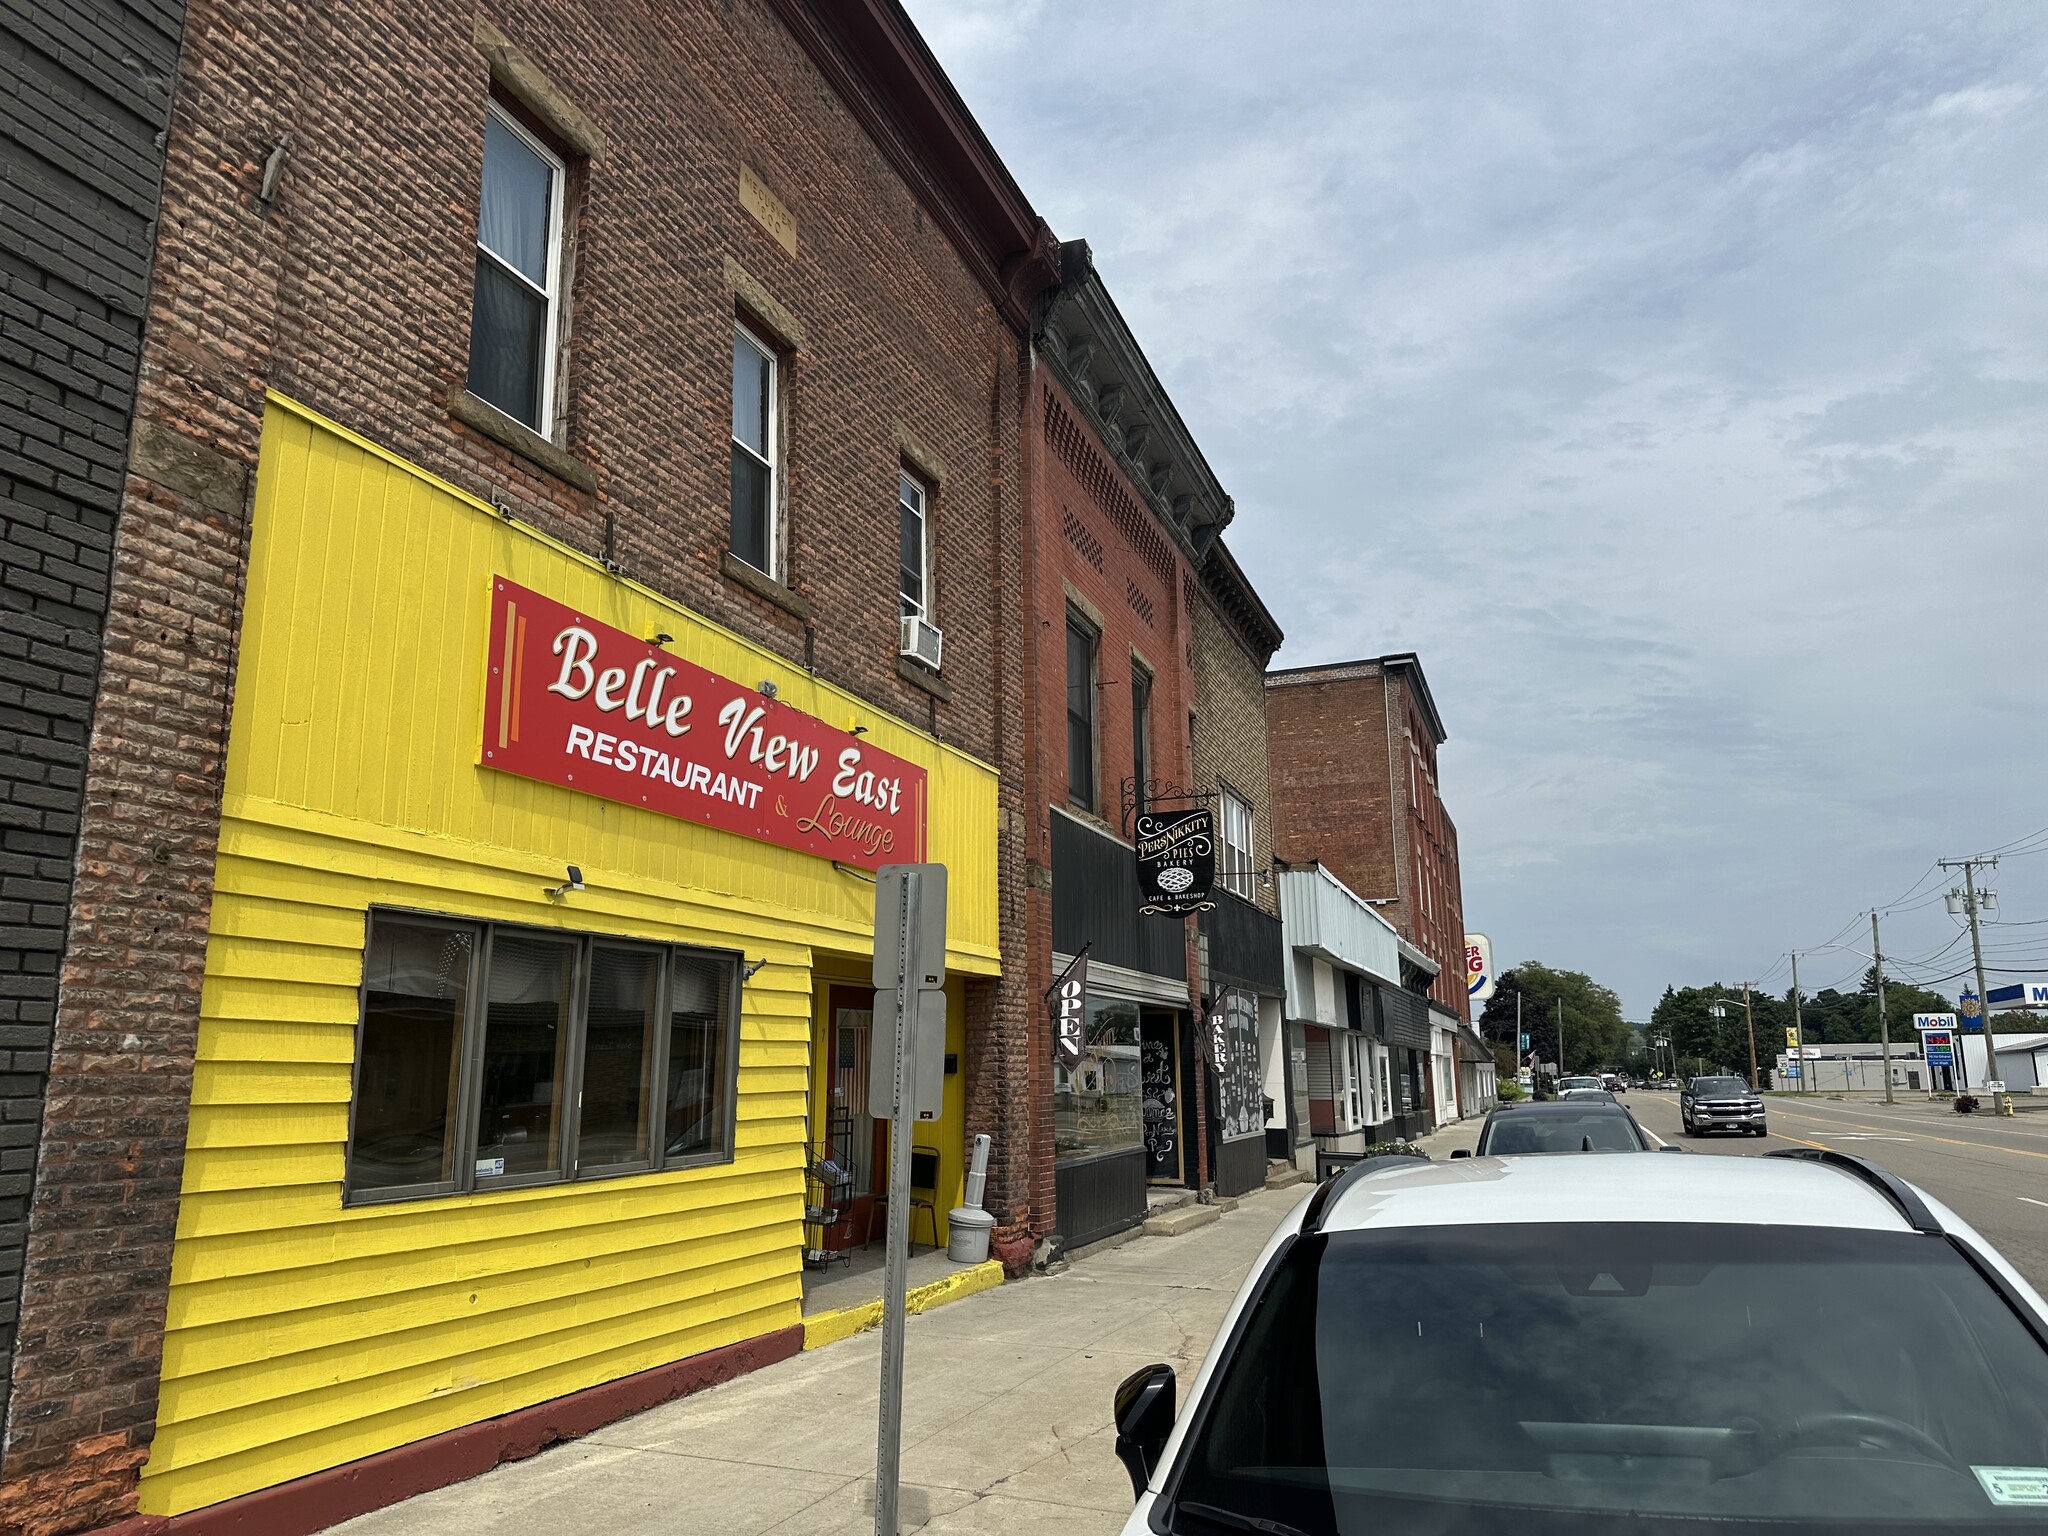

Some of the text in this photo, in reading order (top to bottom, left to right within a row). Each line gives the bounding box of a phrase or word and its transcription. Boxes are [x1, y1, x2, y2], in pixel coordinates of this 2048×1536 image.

[548, 625, 903, 816] Belle View East
[565, 724, 896, 856] RESTAURANT & Lounge
[1173, 847, 1194, 859] PIES
[1157, 859, 1194, 868] BAKERY
[1174, 892, 1205, 901] BAKESHOP
[1059, 980, 1082, 1057] OPEN
[1917, 1016, 1954, 1027] Mobil
[1211, 1014, 1228, 1074] BAKERY
[1991, 1482, 2004, 1494] 5
